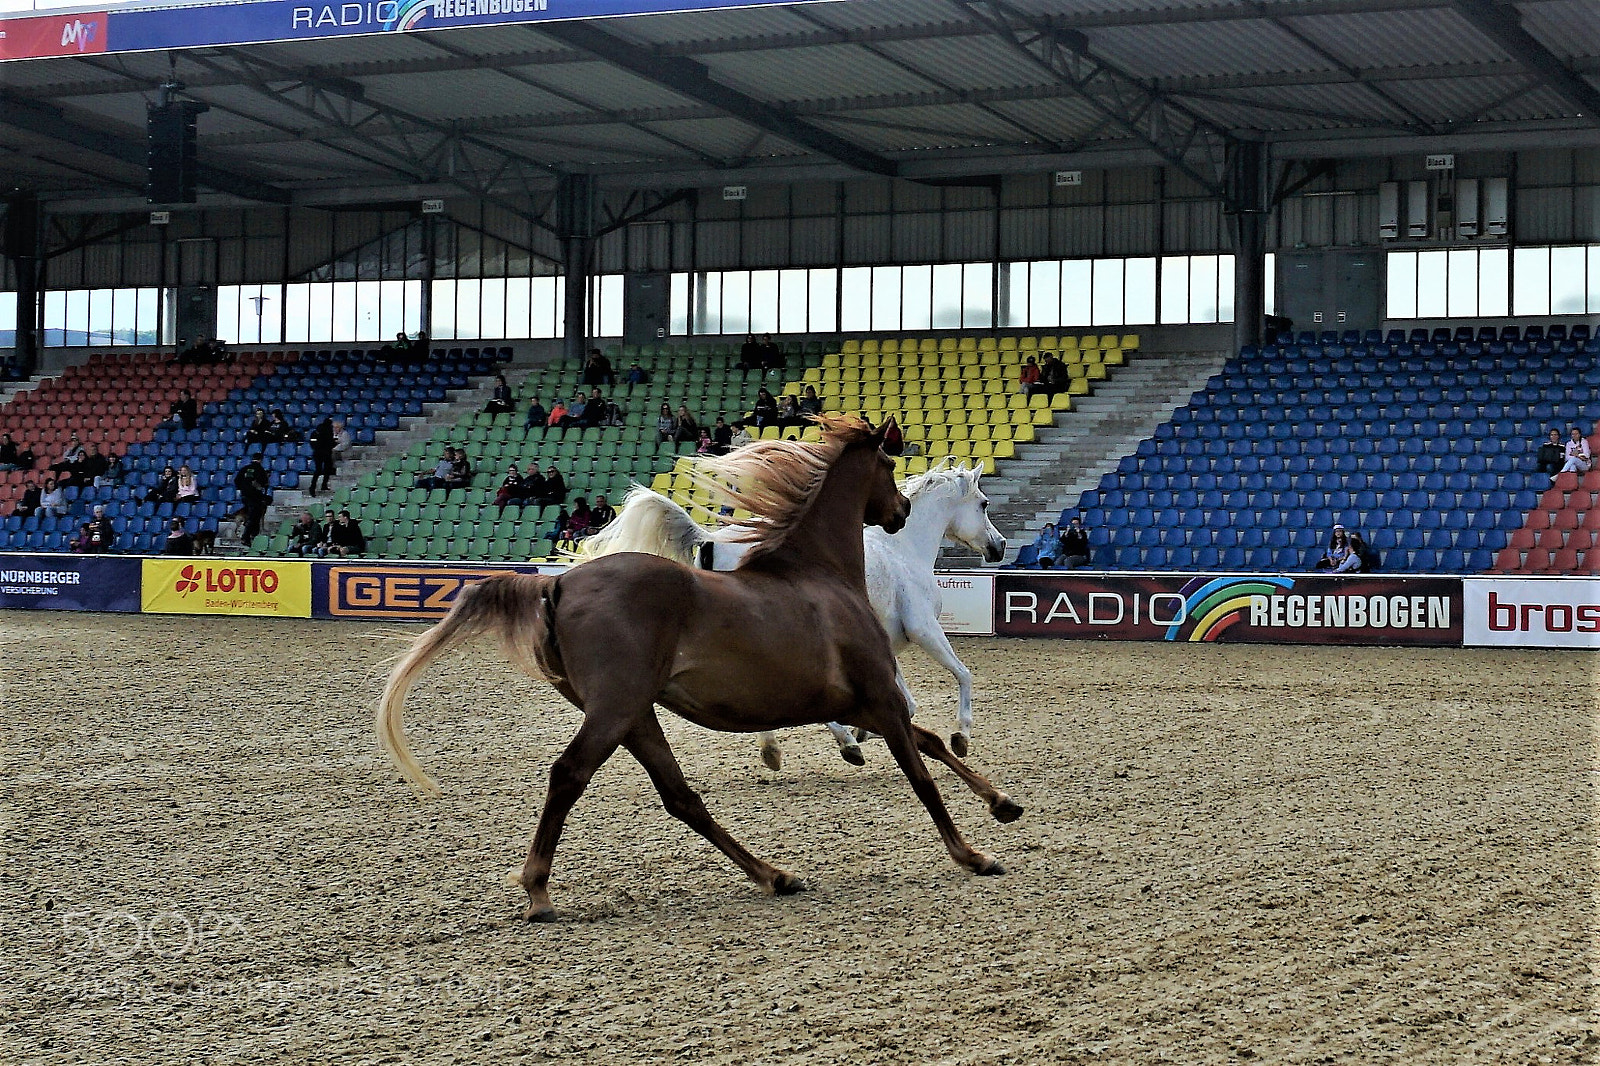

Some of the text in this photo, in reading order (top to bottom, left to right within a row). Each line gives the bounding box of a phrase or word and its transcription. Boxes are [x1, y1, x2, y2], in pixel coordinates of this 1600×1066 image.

[292, 0, 548, 29] RADIO REGENBOGEN
[0, 586, 59, 595] VERSICHERUNG
[206, 568, 279, 594] LOTTO
[346, 576, 484, 608] GEZ
[1004, 591, 1451, 629] RADIO REGENBOGEN
[1488, 591, 1600, 633] bros
